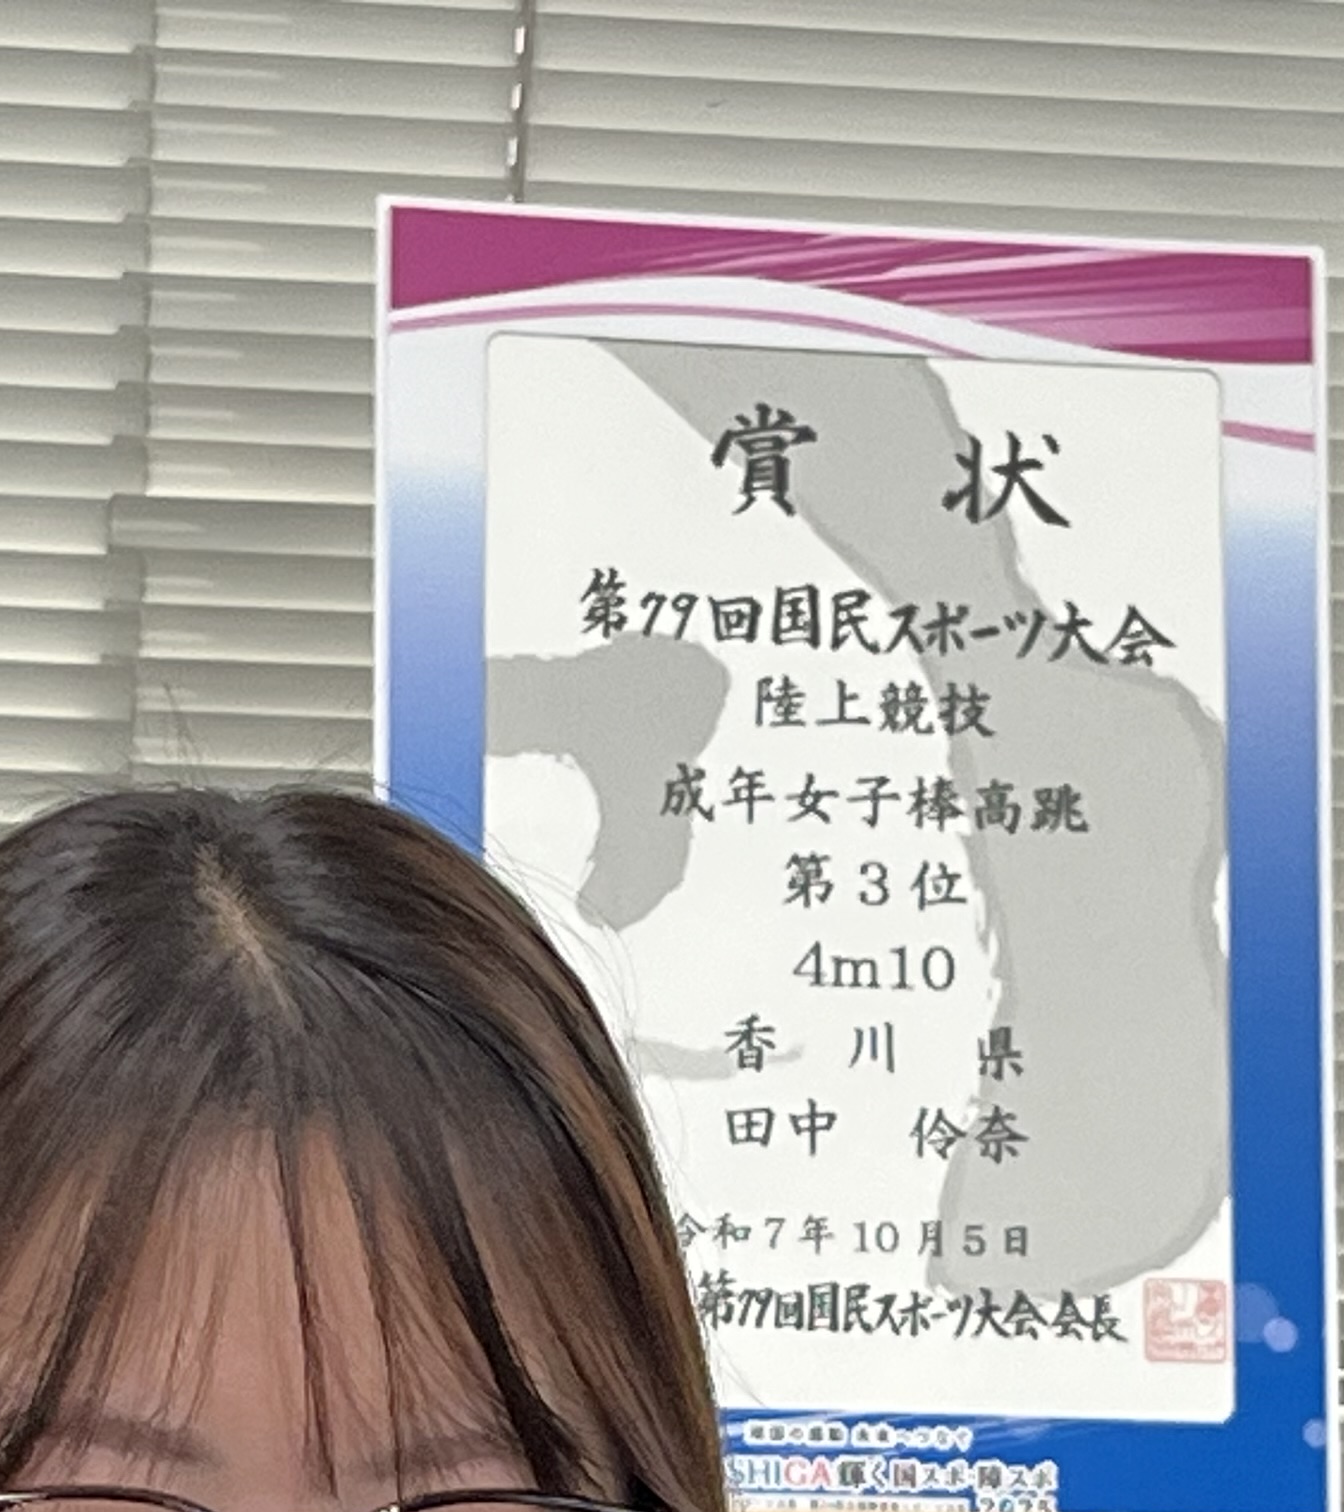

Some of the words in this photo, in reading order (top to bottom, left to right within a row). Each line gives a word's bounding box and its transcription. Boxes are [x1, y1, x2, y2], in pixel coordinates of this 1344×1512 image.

[711, 404, 1071, 528] 賞状
[580, 568, 1177, 666] 第79回国民スポーツ大会
[755, 676, 995, 738] 陸上競技
[660, 764, 1090, 834] 成年女子棒高跳
[785, 854, 968, 909] 第3位
[793, 941, 957, 991] 4m10
[726, 1099, 838, 1155] 田中
